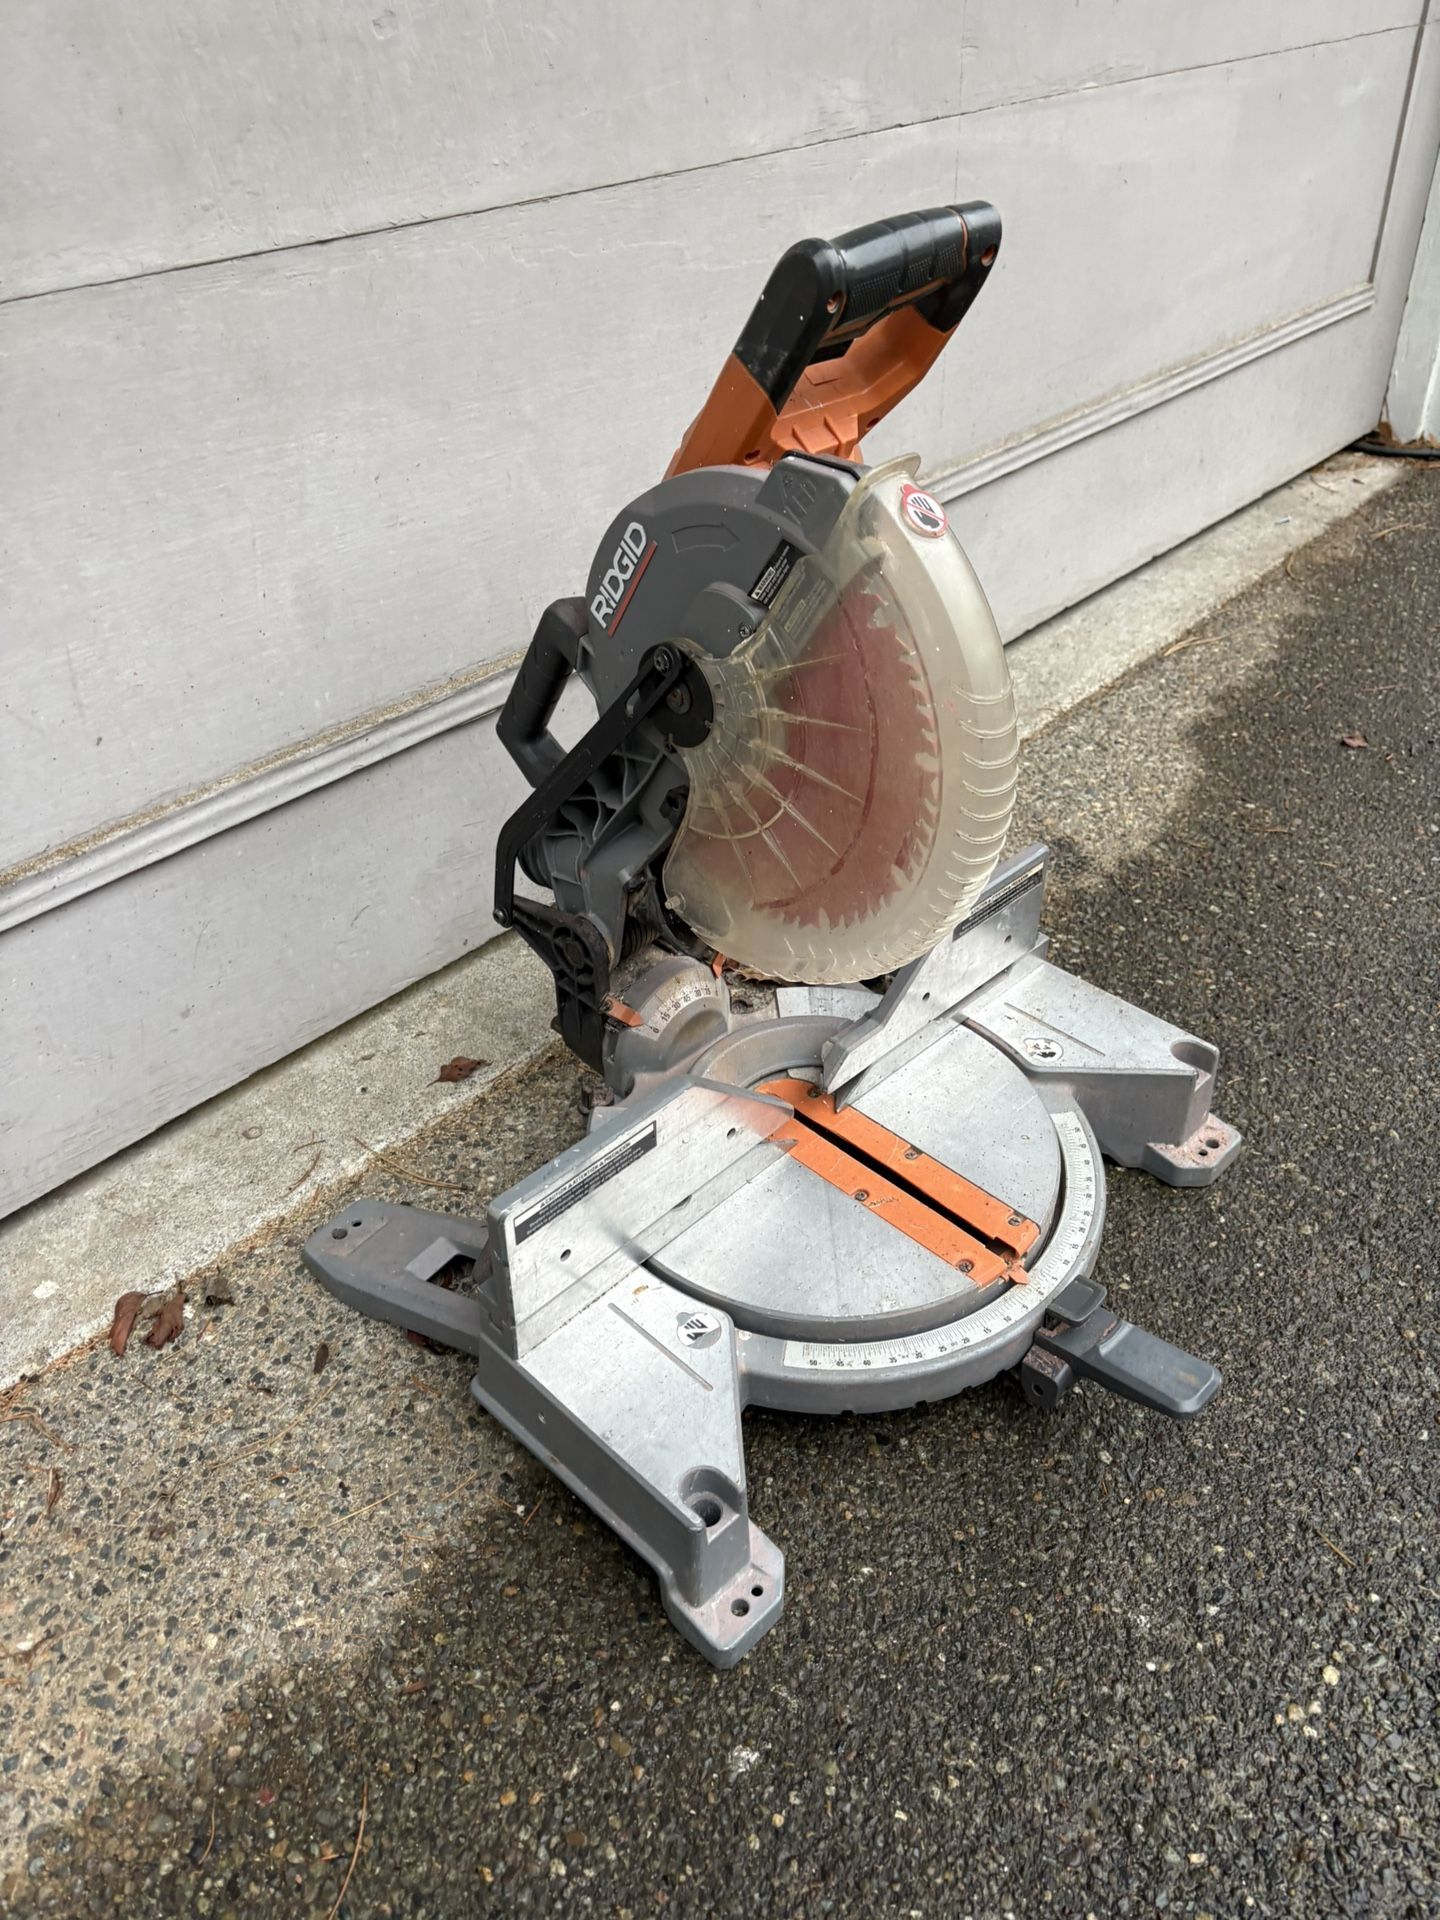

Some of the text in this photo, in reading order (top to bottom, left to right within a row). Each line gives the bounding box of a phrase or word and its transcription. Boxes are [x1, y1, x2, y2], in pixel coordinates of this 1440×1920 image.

[590, 521, 647, 629] RIDGID
[661, 1011, 671, 1021] 15
[671, 1000, 681, 1010] 30
[809, 1359, 818, 1367] 50
[961, 1336, 970, 1344] 20
[983, 1327, 992, 1335] 15
[1003, 1315, 1012, 1323] 10
